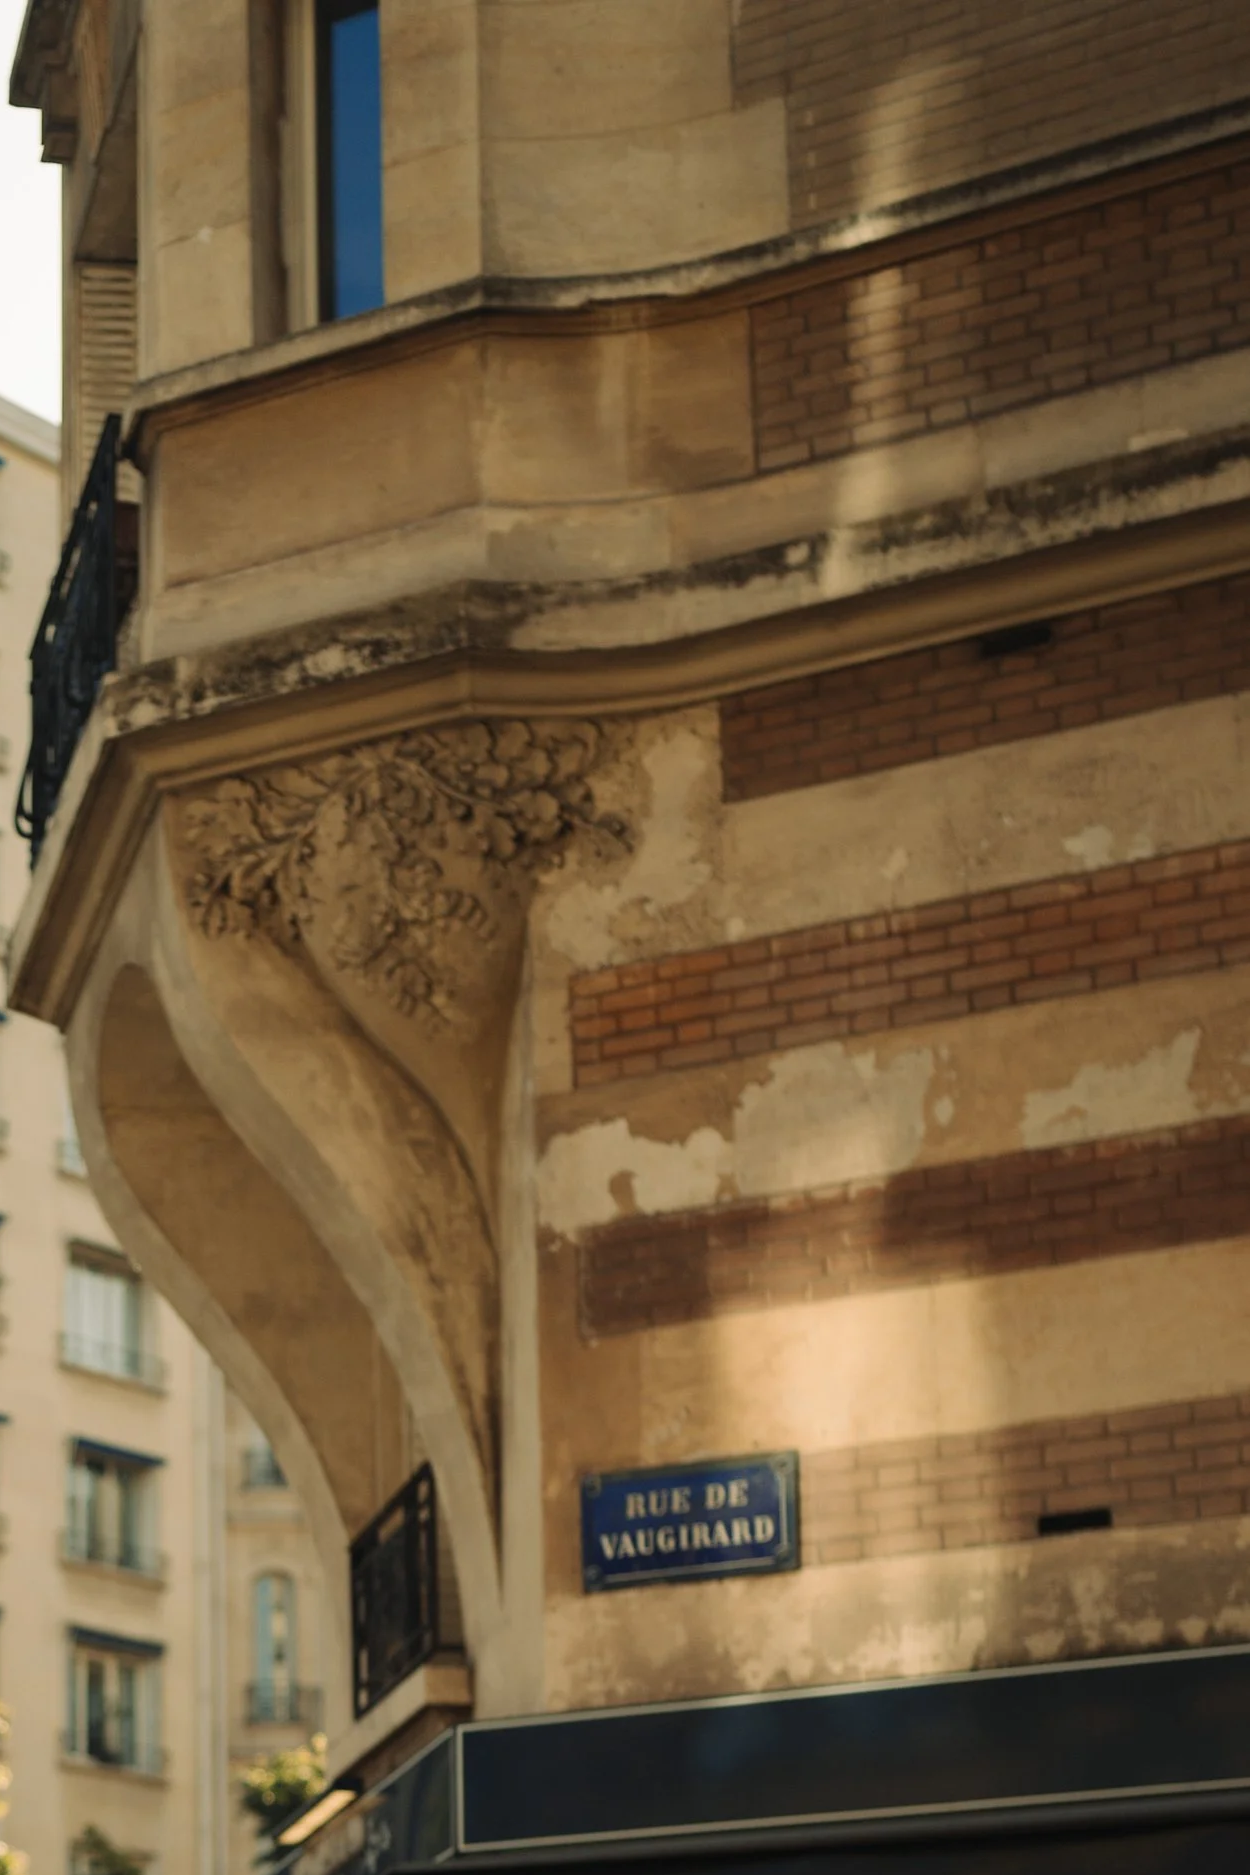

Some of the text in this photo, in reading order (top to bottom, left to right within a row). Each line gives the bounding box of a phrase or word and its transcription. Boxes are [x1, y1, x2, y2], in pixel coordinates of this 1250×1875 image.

[625, 1478, 749, 1520] RUE DE
[600, 1514, 775, 1560] VAUGIRARD
